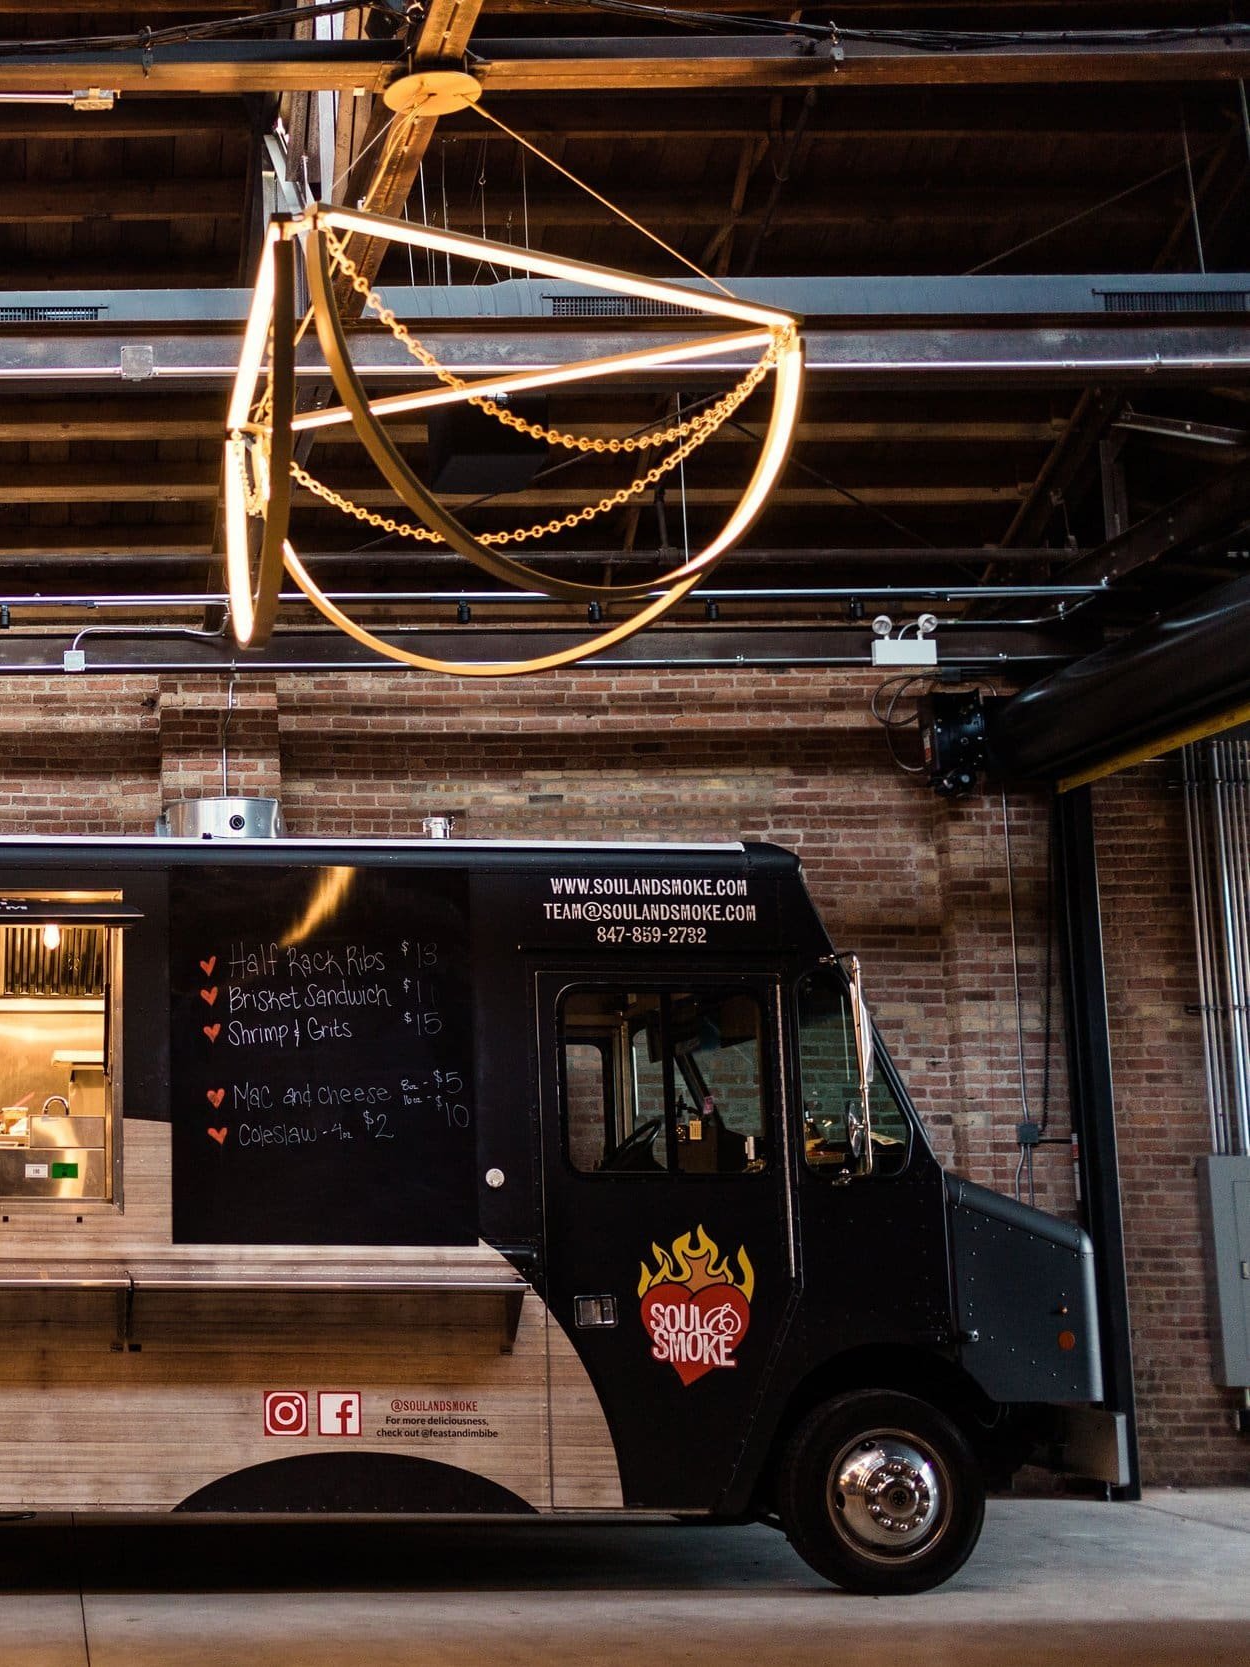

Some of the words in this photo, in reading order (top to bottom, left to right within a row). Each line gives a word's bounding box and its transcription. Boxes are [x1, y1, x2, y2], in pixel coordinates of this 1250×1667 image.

[550, 878, 748, 896] WWW.SOULANDSMOKE.COM
[543, 901, 757, 922] TEAM@SOULANDSMOKE.COM
[597, 926, 707, 944] 847-859-2732
[229, 941, 278, 978] Half
[347, 945, 386, 976] Ribs
[228, 985, 301, 1013] Brisket
[305, 979, 392, 1007] Sandwich
[228, 1020, 288, 1047] Shrimp
[307, 1016, 352, 1041] Grits
[282, 1083, 313, 1107] and
[238, 1123, 317, 1147] Coleslaw
[653, 1329, 735, 1366] SMOKE
[391, 1399, 478, 1413] @SOULANDSMOKE
[386, 1416, 400, 1425] For
[402, 1417, 426, 1425] more
[427, 1416, 489, 1426] deliciousness,
[376, 1428, 404, 1437] check
[404, 1429, 419, 1437] out
[421, 1428, 498, 1438] @feastandimbibe
